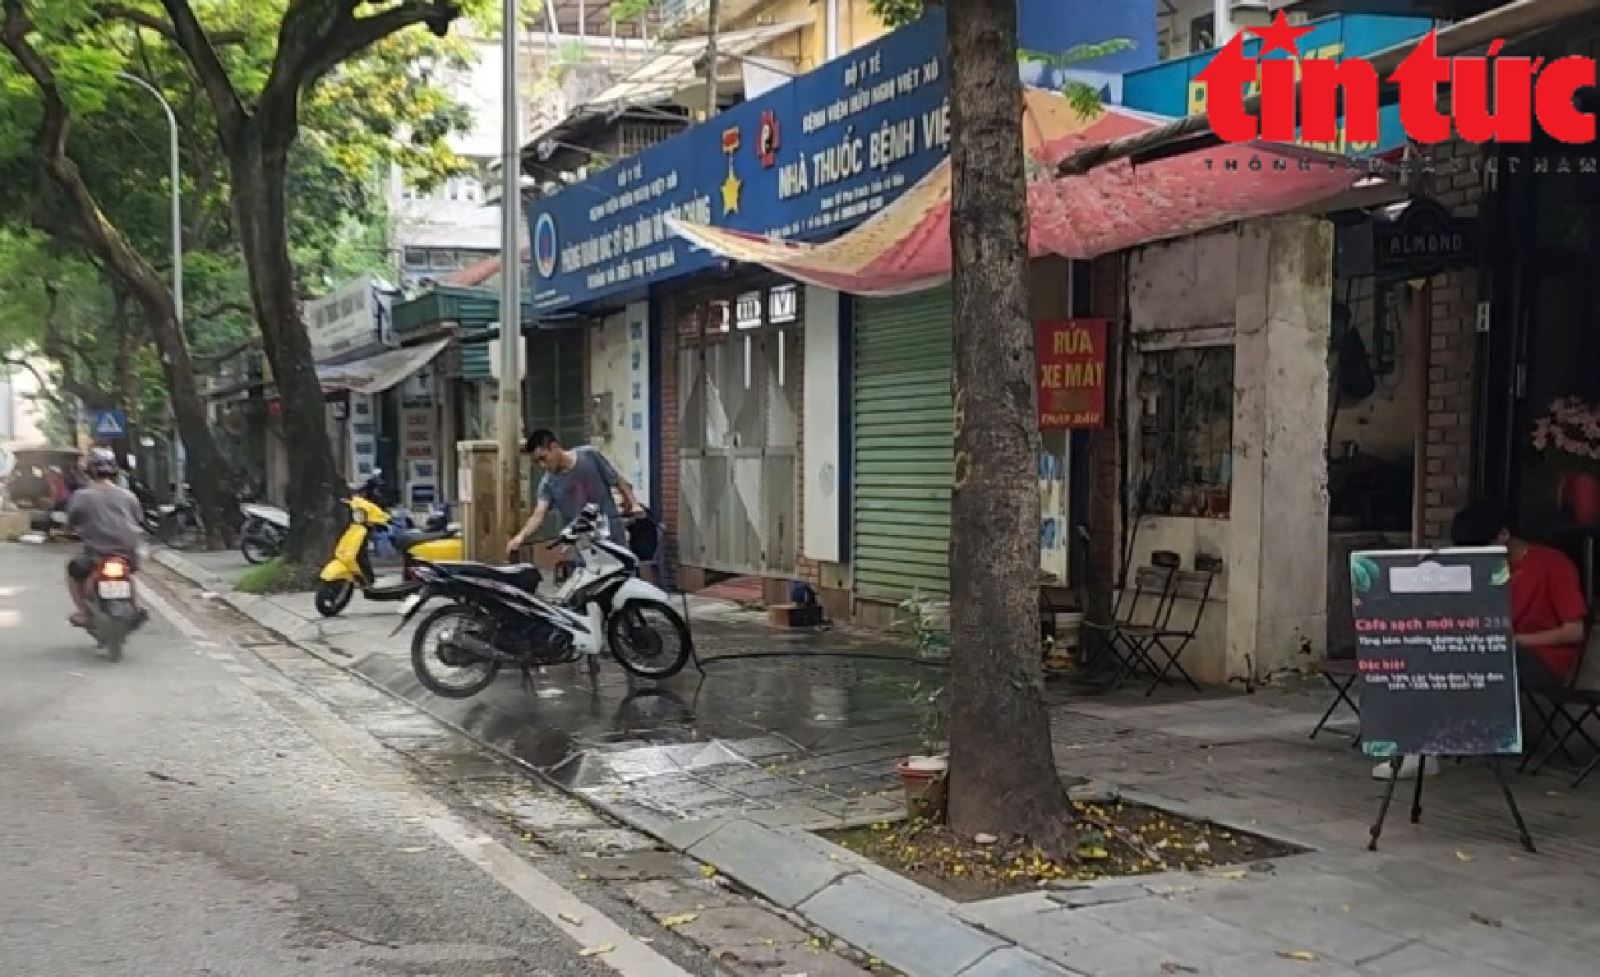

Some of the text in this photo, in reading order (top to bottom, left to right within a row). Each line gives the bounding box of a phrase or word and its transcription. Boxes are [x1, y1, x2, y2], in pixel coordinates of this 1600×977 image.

[778, 152, 808, 200] NHÀ
[813, 125, 863, 187] THUỐC
[870, 119, 915, 172] BỆNH
[923, 96, 950, 151] VIỆ
[1391, 233, 1462, 254] ALMOND
[1041, 364, 1062, 389] XE
